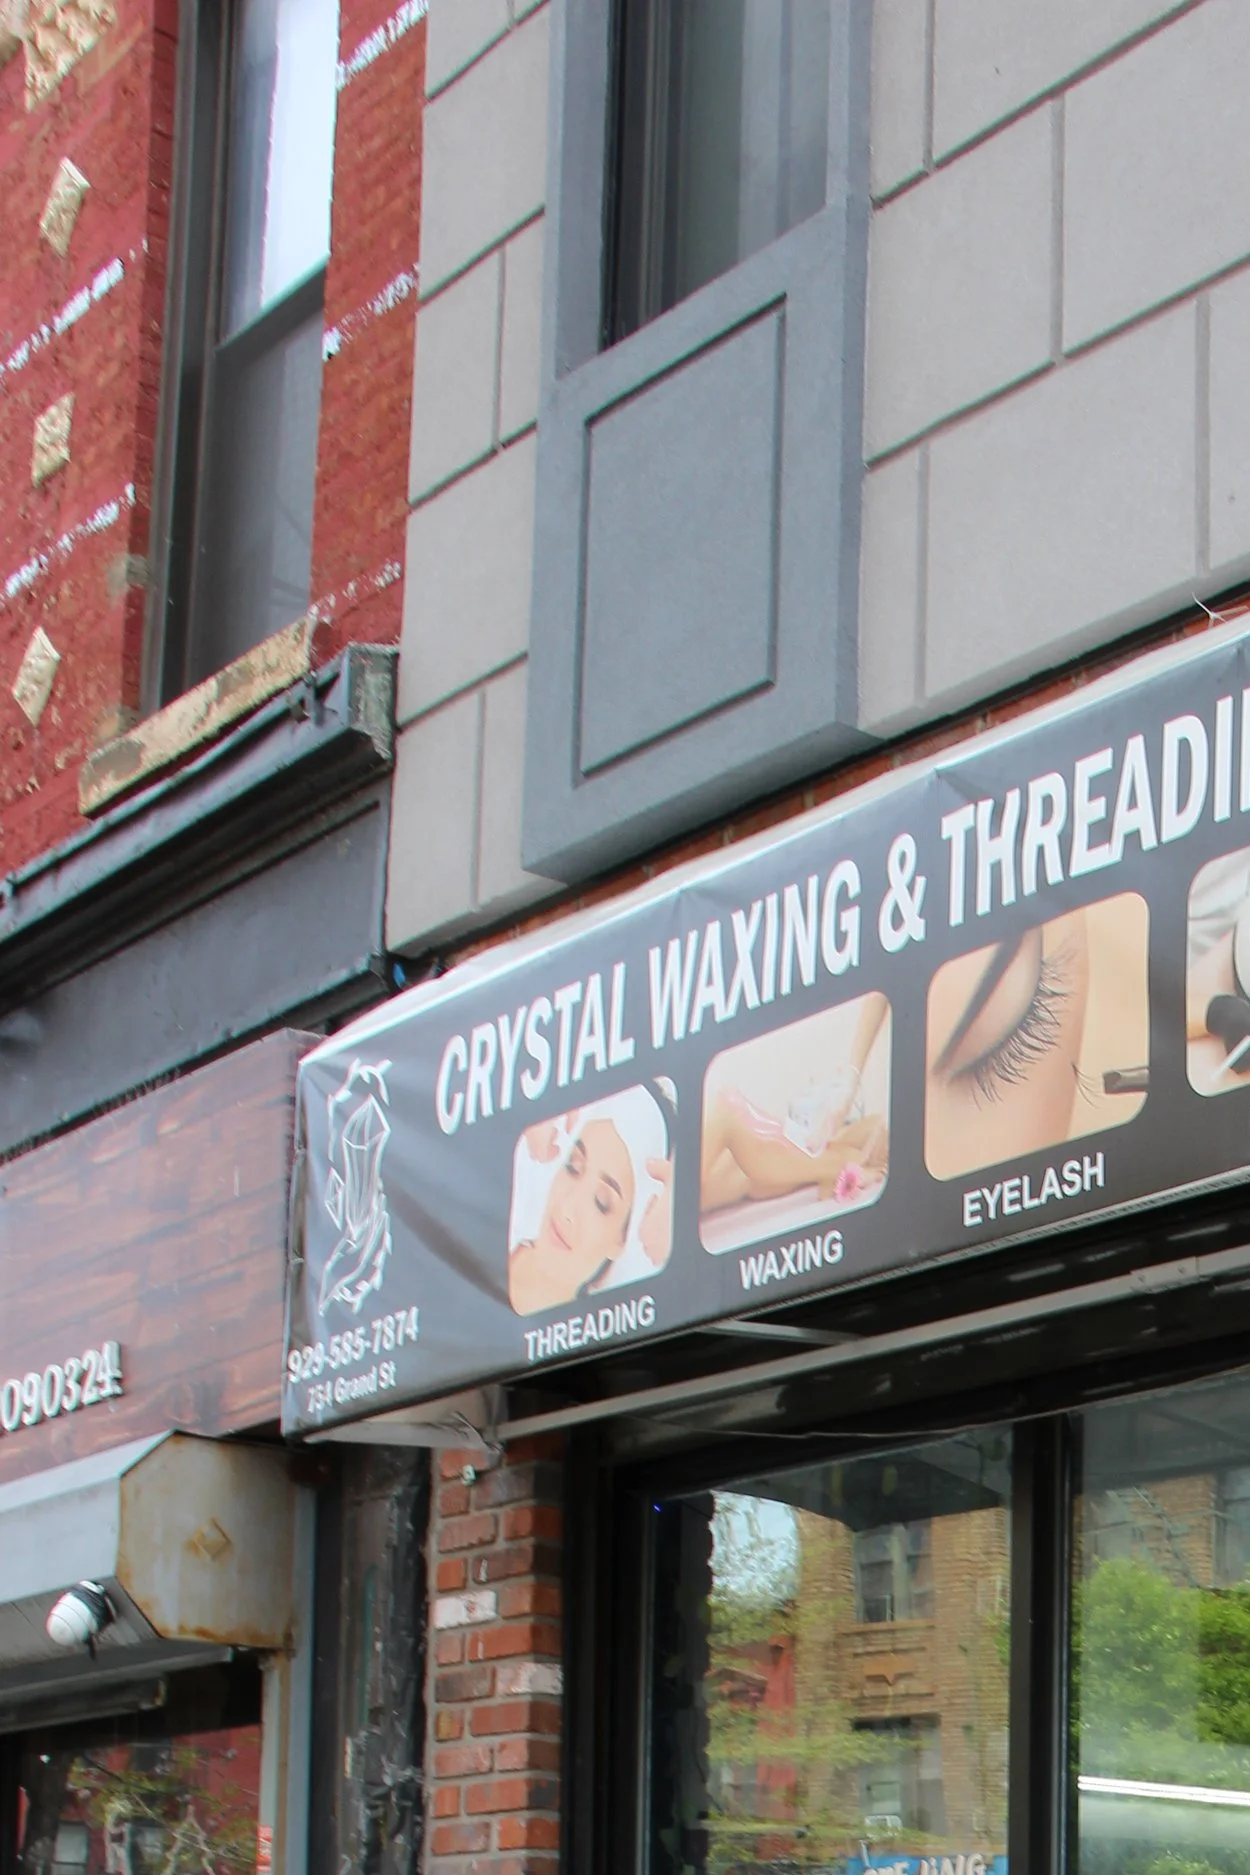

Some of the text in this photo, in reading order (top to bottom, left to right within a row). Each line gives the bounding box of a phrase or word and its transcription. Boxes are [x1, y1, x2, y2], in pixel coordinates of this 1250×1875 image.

[435, 963, 635, 1135] CRYSTAL
[648, 858, 862, 1050] WAXING
[878, 833, 928, 954] &
[961, 1152, 1107, 1228] EYELASH
[738, 1230, 845, 1292] WAXING
[524, 1295, 657, 1362] THREADING
[334, 1365, 378, 1404] Grand
[379, 1360, 397, 1390] St
